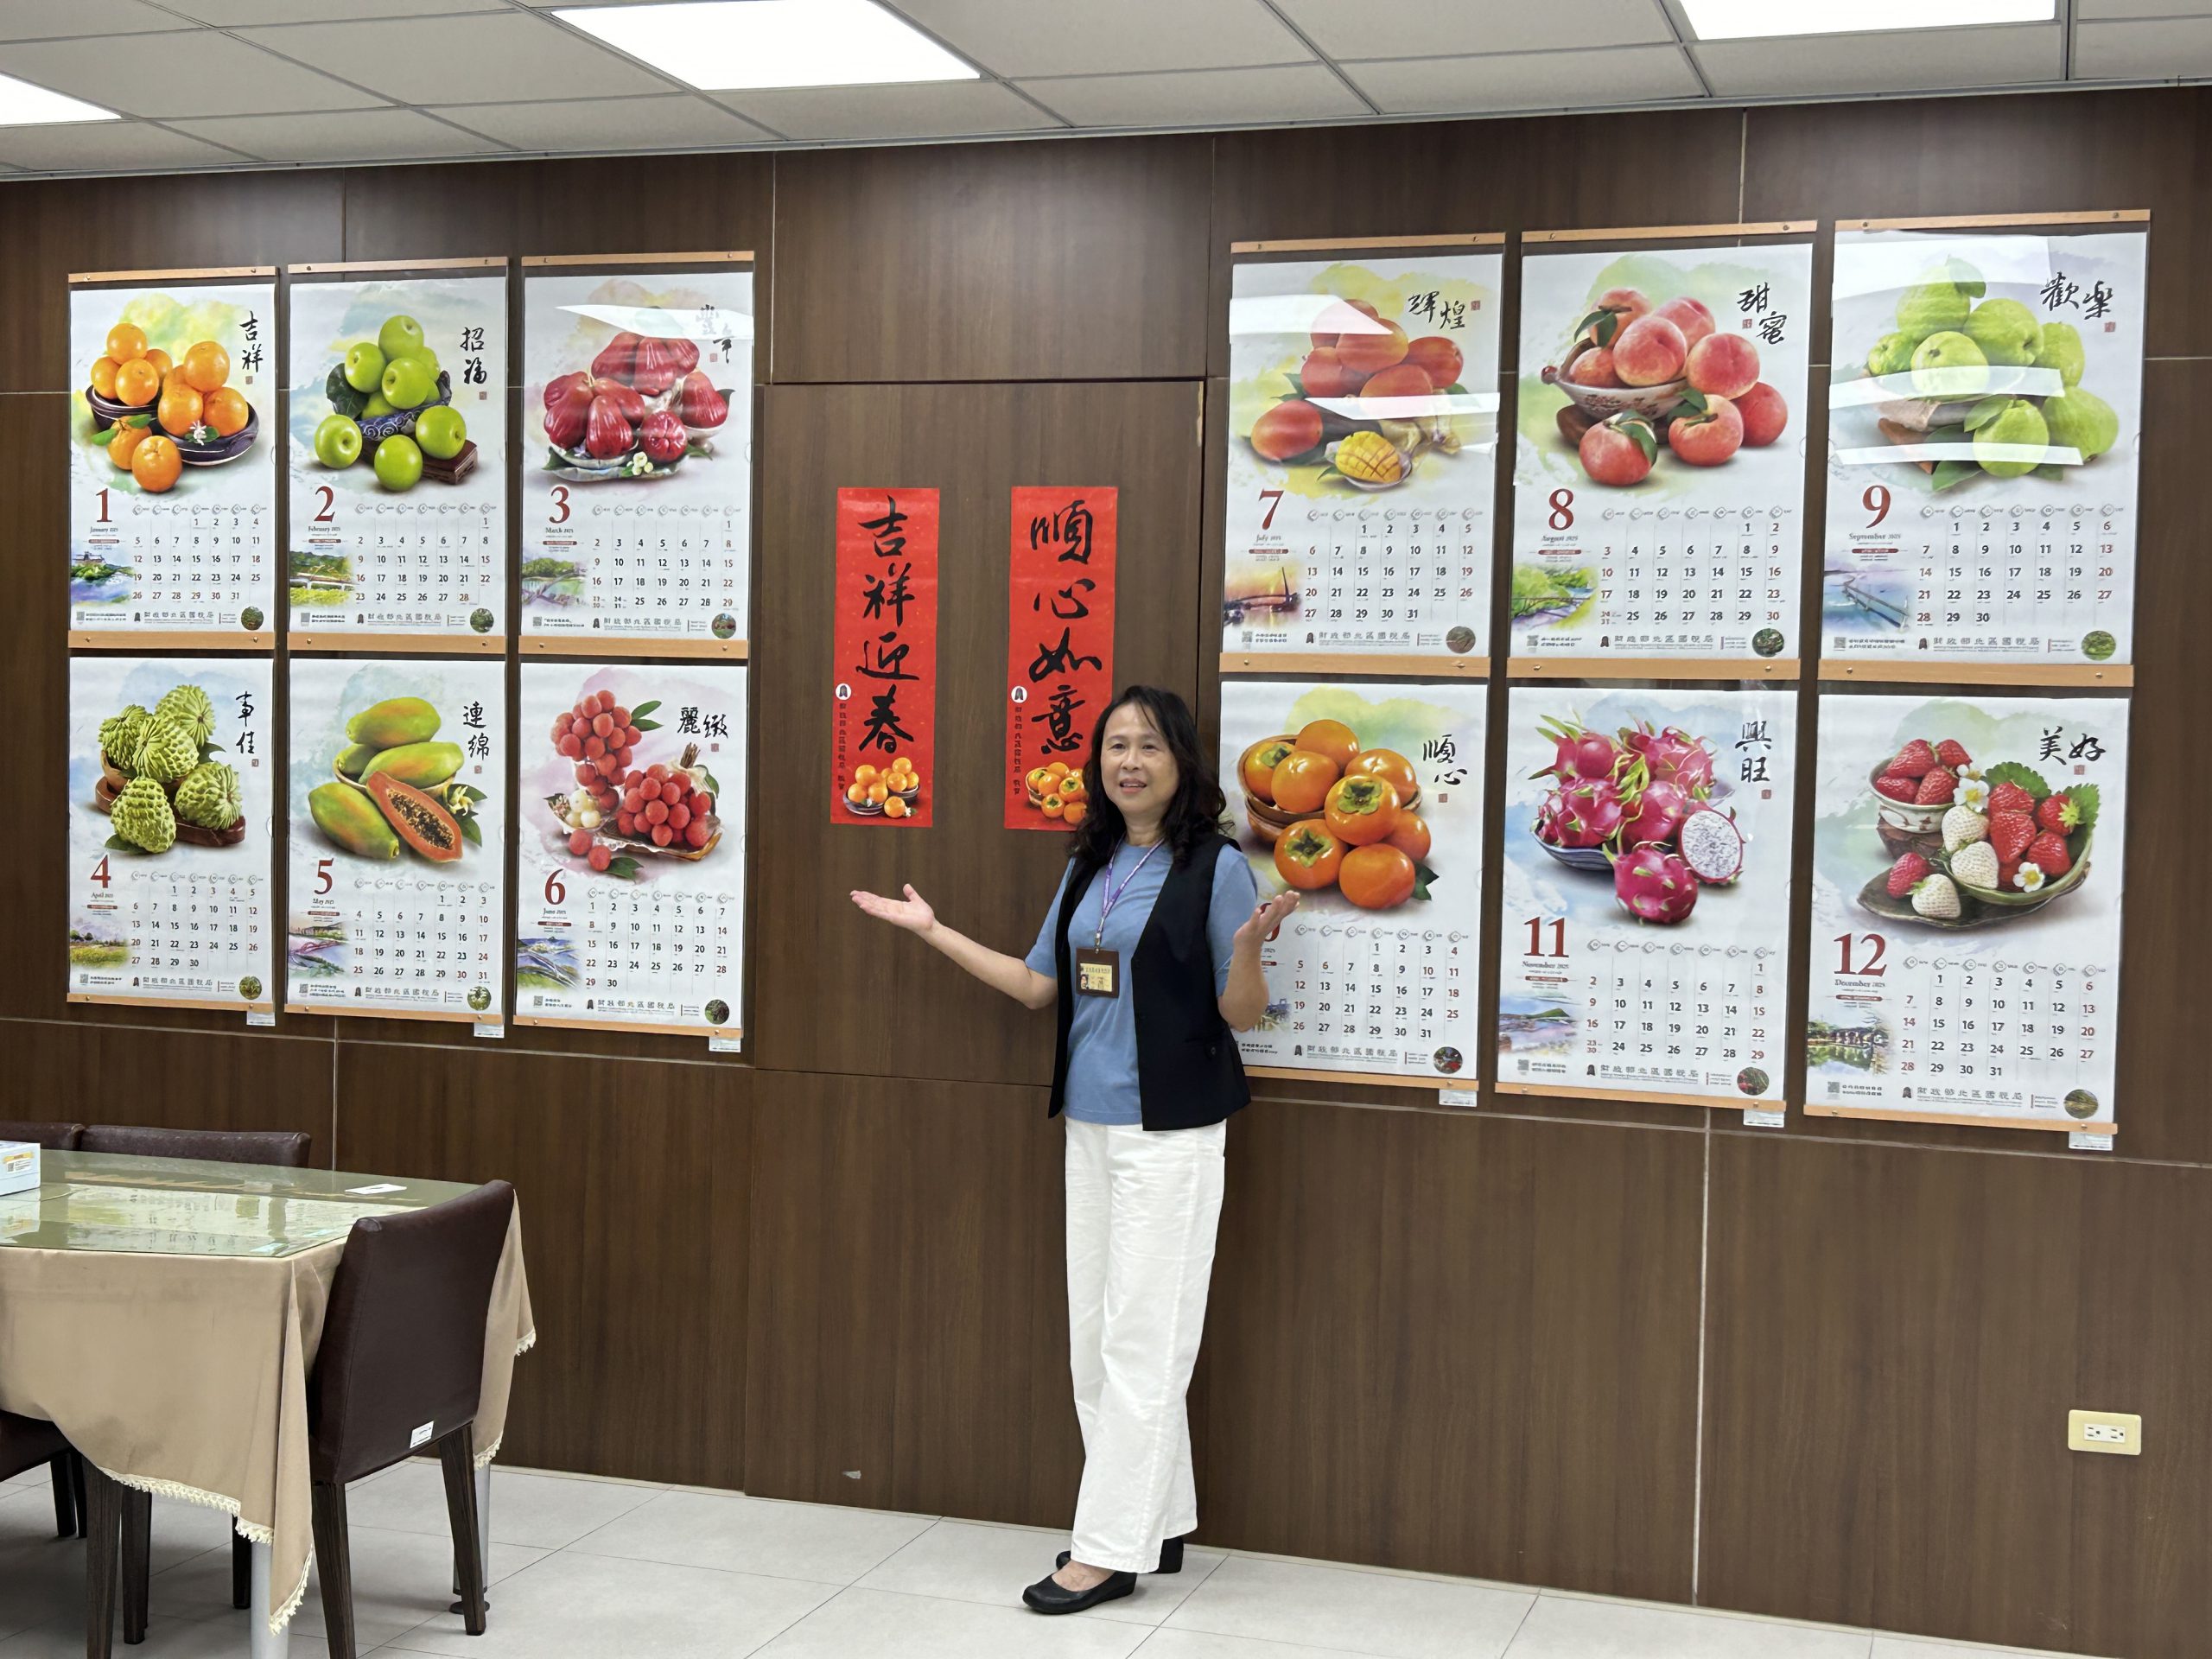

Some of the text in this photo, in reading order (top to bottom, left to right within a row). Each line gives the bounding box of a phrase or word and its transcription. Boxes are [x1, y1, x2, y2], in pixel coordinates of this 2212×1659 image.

[2039, 270, 2113, 321] 歡樂
[239, 310, 264, 372] 吉祥
[460, 327, 487, 385] 招福
[95, 487, 112, 523] 1
[314, 486, 335, 523] 2
[549, 486, 570, 524] 3
[1258, 487, 1285, 531] 7
[1548, 488, 1574, 531] 8
[1862, 485, 1891, 530] 9
[132, 554, 262, 564] 12 13 14 15 16 17 18
[1306, 565, 1474, 577] 13 14 15 16 17 18 19
[1601, 566, 1783, 578] 10 11 12 13 14 15 16
[1918, 566, 2114, 578] 14 15 16 17 18 19 20
[355, 573, 492, 583] 16 17 18 19 20 21 22
[591, 576, 734, 588] 16 17 18 19 20 21 22
[1916, 588, 2113, 601] 21 22 23 24 25 26 27
[855, 495, 919, 753] 吉祥迎春
[1028, 499, 1103, 754] 順心如意
[1916, 612, 1991, 623] 28 29 30
[462, 701, 490, 760] 連綿
[2039, 725, 2106, 766] 美好
[1422, 734, 1468, 785] 順心
[1735, 721, 1772, 783] 興旺
[90, 854, 111, 889] 4
[314, 857, 334, 895] 5
[544, 868, 566, 906] 6
[131, 919, 258, 934] 13 14 15 16 17 18 19
[1522, 916, 1569, 958] 11
[353, 946, 489, 962] 18 19 20 21 22 23 24
[587, 938, 727, 956] 15 16 17 18 19 20 21
[1833, 932, 1887, 977] 12
[1294, 980, 1460, 999] 12 13 14 15 16 17 18
[1834, 978, 1871, 988] December
[1586, 1018, 1765, 1039] 16 17 18 19 20 21 22
[1902, 1016, 2096, 1037] 14 15 16 17 18 19 20
[1901, 1039, 2095, 1060] 21 22 23 24 25 26 27
